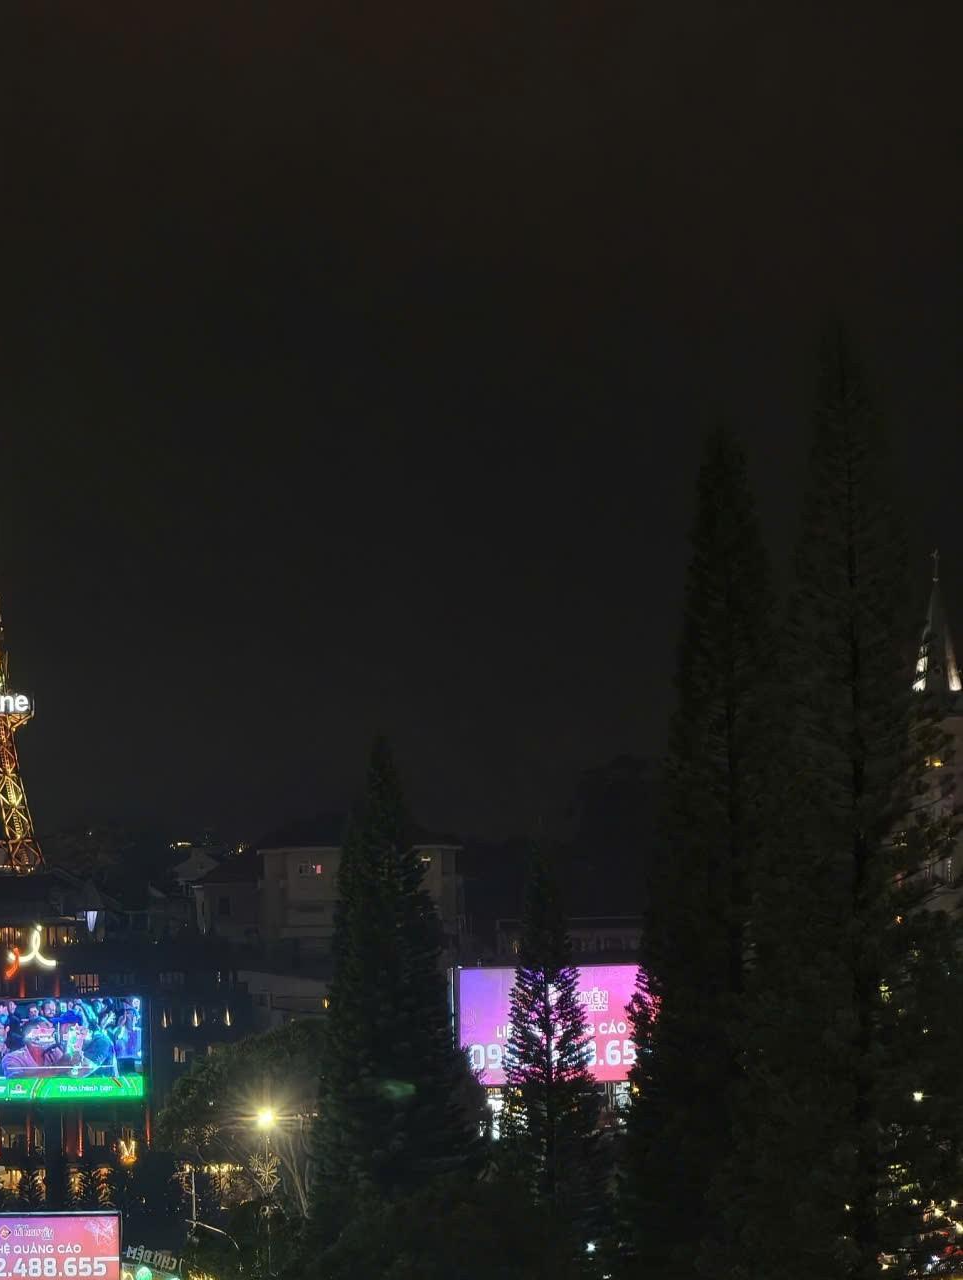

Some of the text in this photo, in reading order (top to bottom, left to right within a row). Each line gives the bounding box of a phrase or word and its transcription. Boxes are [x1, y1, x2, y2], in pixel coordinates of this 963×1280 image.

[598, 1019, 627, 1034] CÁO
[14, 1242, 54, 1255] QUẢNG
[57, 1241, 82, 1254] CÁO
